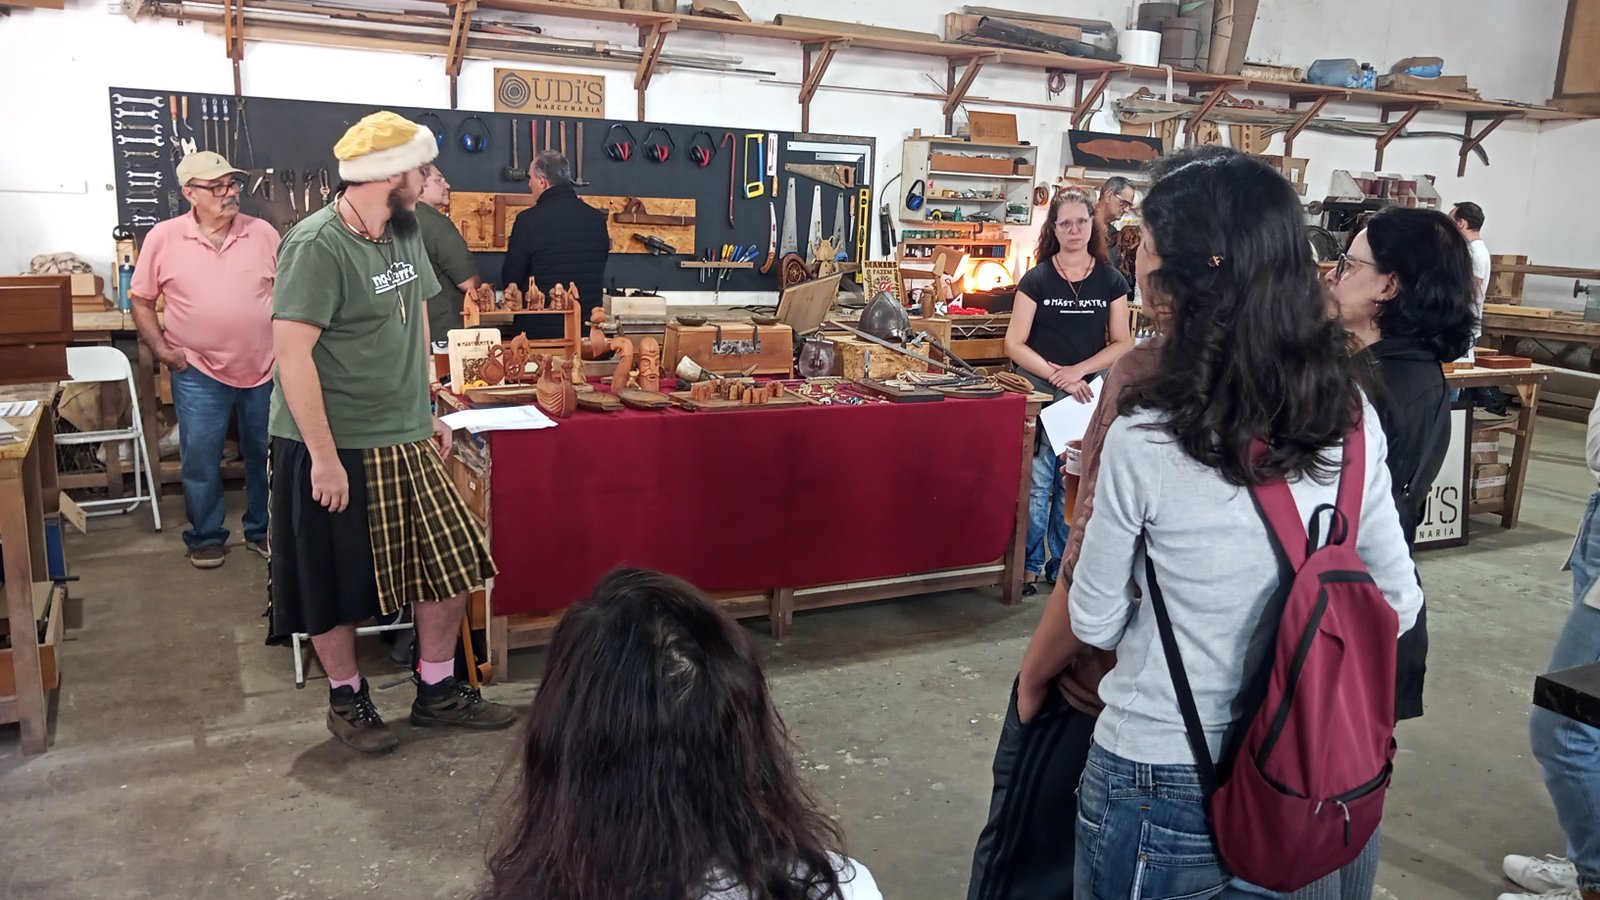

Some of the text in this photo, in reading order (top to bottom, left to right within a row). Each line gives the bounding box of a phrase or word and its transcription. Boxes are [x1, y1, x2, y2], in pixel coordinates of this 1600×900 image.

[532, 77, 603, 105] UDi'S
[536, 104, 601, 113] MARCENARIA
[1419, 528, 1454, 539] NARIA
